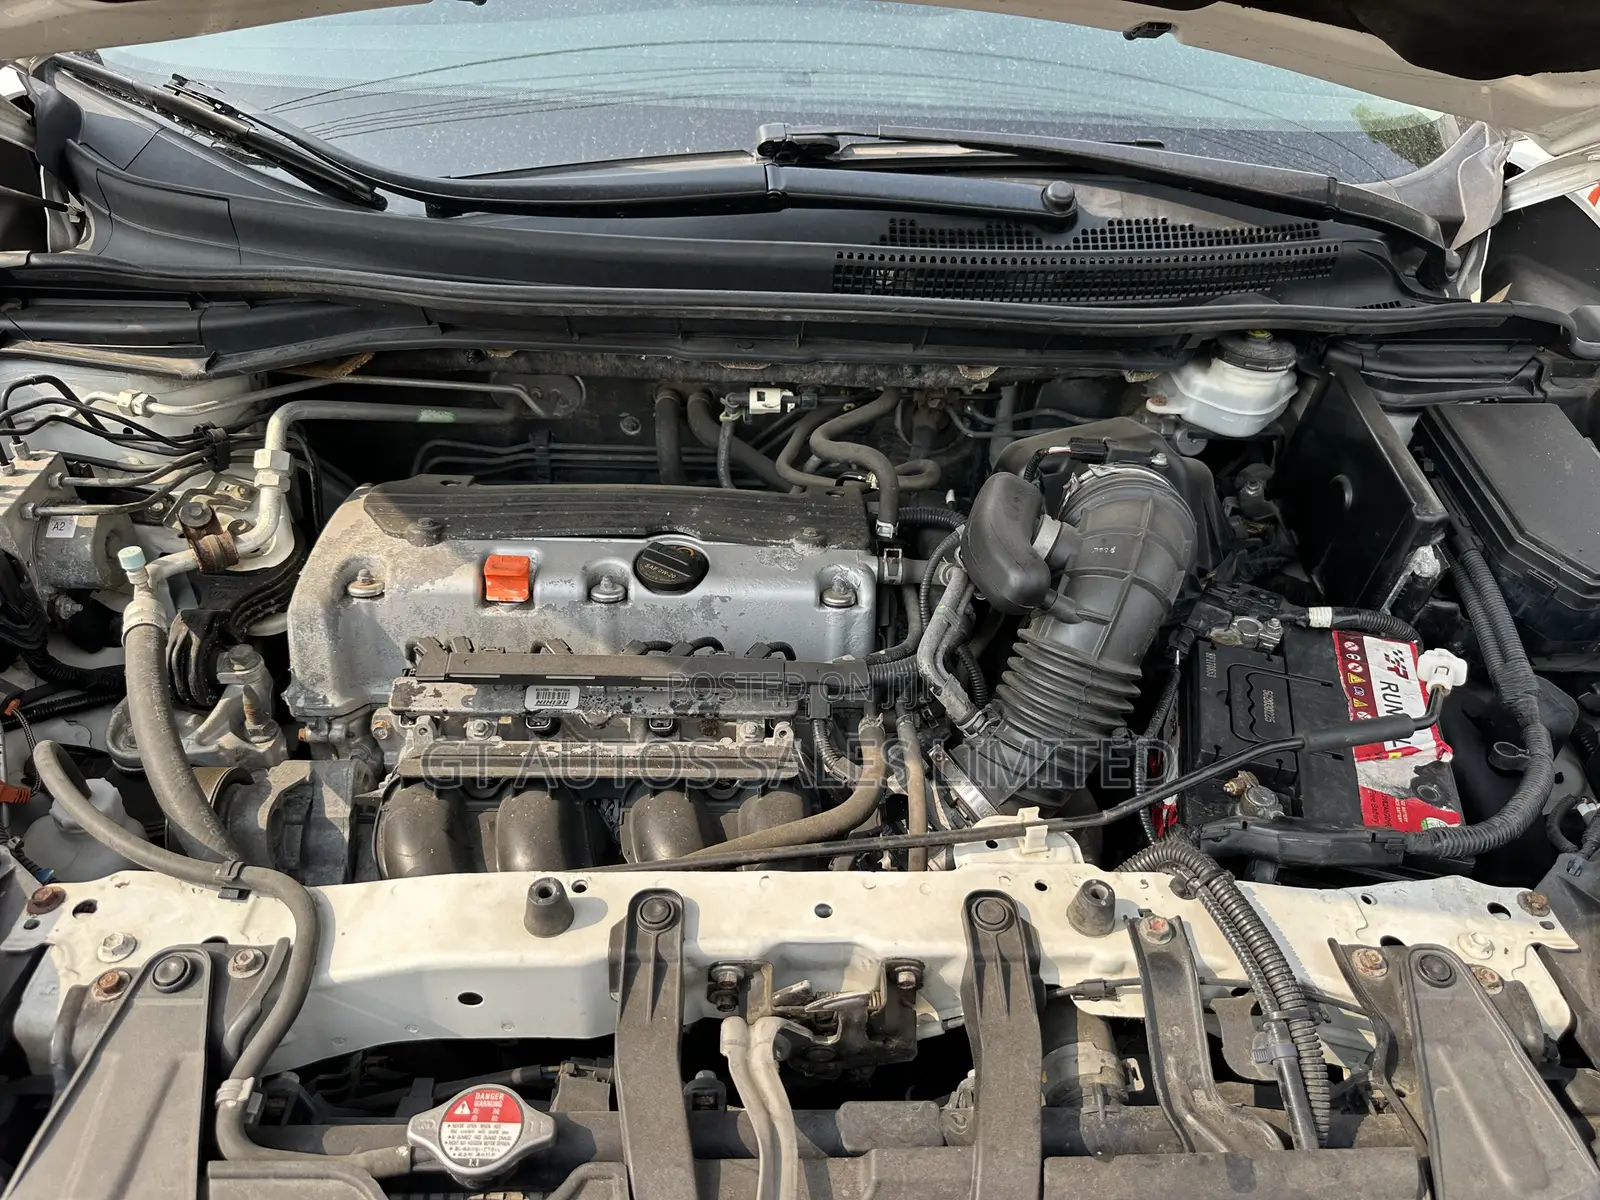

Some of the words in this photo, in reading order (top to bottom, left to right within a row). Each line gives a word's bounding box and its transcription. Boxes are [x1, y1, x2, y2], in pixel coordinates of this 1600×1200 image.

[52, 521, 66, 531] A2
[1379, 680, 1412, 748] RUNL
[475, 1092, 504, 1100] DANGER
